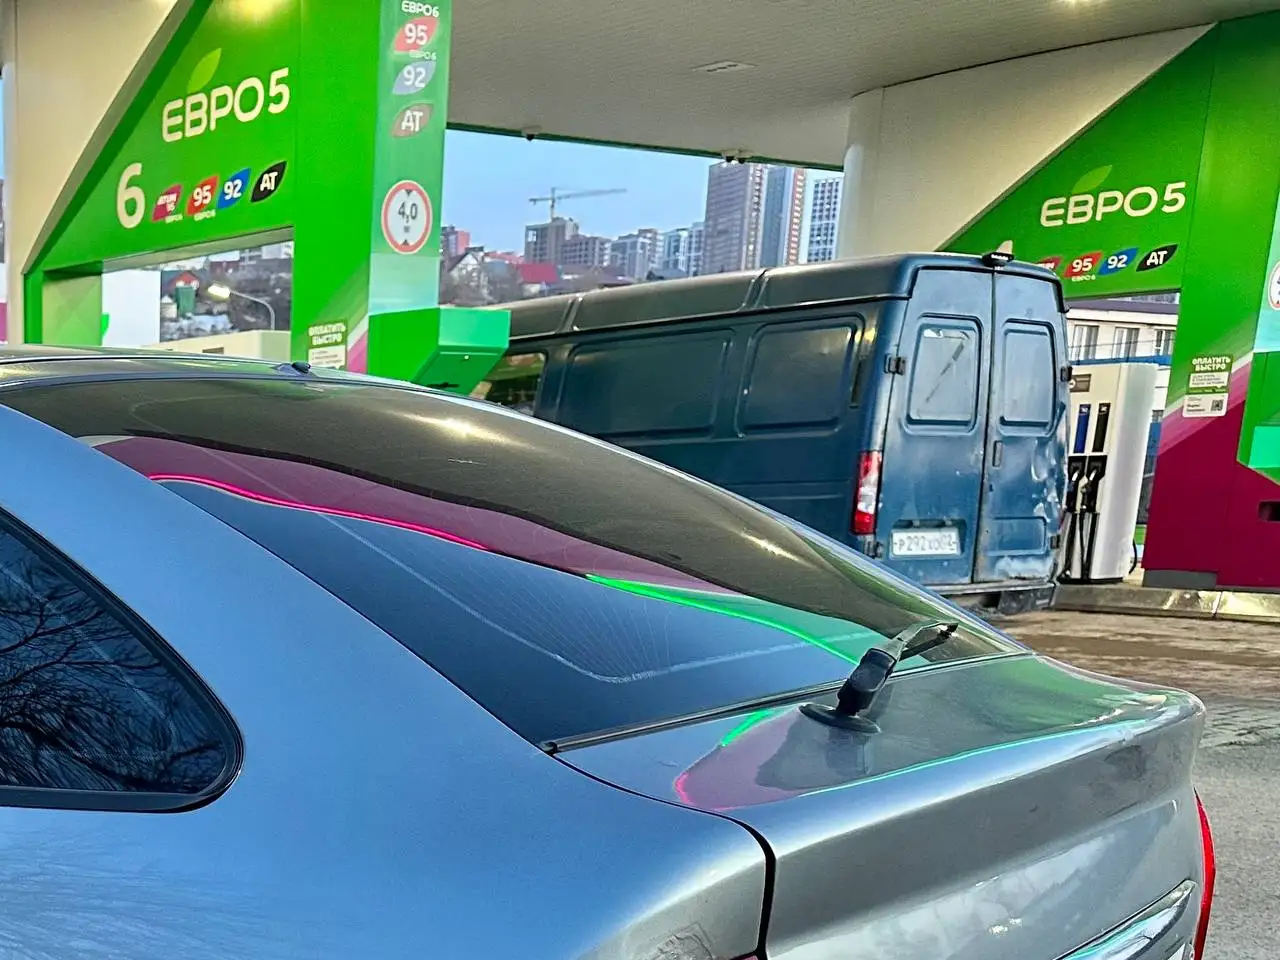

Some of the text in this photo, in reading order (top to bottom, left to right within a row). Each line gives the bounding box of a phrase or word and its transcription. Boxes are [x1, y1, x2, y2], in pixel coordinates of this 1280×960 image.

[404, 23, 428, 46] 95
[403, 65, 426, 88] 92
[117, 162, 146, 229] 6
[193, 184, 212, 207] 95
[224, 179, 243, 200] 92
[1072, 257, 1094, 272] 95
[1107, 254, 1128, 269] 92
